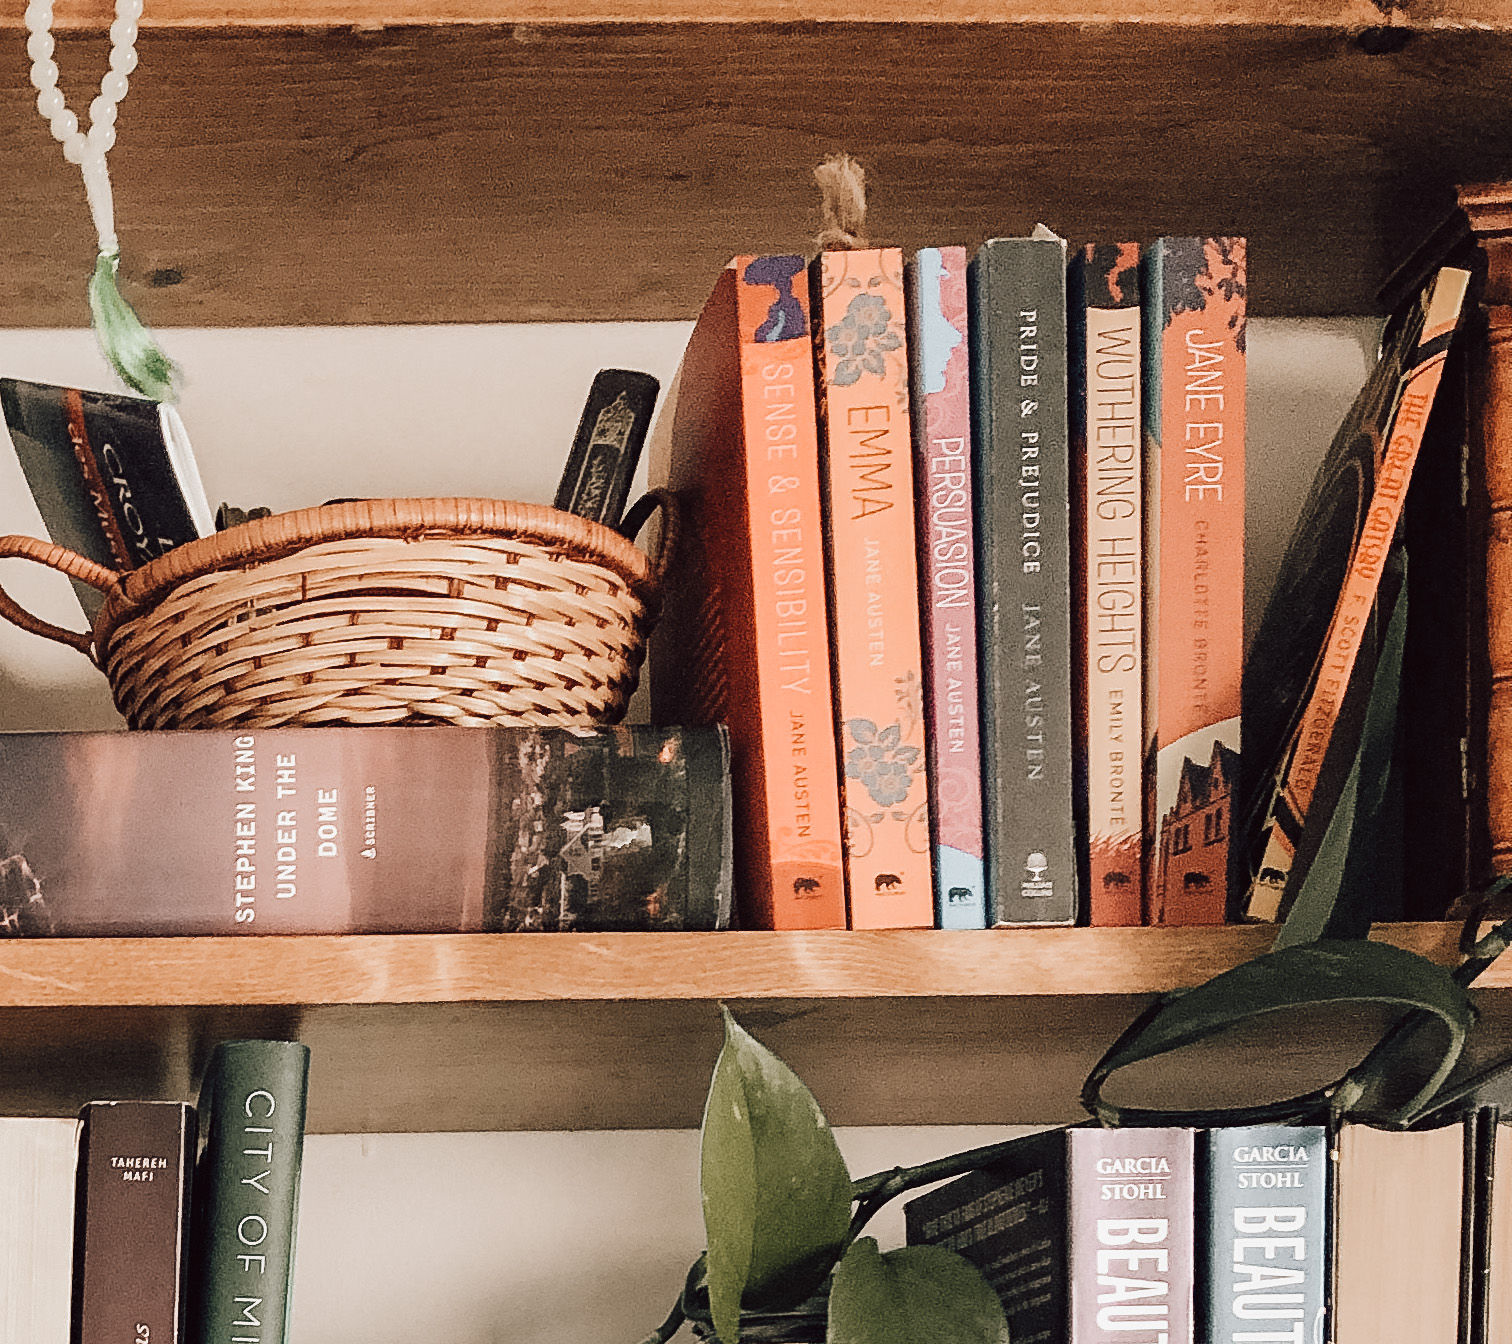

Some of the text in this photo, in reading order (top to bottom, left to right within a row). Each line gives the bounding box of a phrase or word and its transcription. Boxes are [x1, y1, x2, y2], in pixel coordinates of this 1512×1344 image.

[848, 405, 894, 520] EMMA
[1019, 309, 1041, 574] PRIDE & PREJUDICE
[1185, 329, 1224, 502] JANE EYRE
[762, 363, 812, 695] SENSE & SENSIBILITY
[931, 437, 970, 609] PERSUASION
[1096, 327, 1136, 674] WUTHERING HEIGHTS
[234, 735, 256, 924] STEPHEN KING
[276, 753, 297, 899] UNDER THE
[318, 788, 338, 858] DOME
[110, 1157, 167, 1169] TAHEREH
[123, 1171, 154, 1182] MAFI
[241, 1090, 276, 1194] CITY
[1096, 1157, 1171, 1176] GARCIA
[1101, 1184, 1167, 1201] STOHL
[1233, 1145, 1309, 1162] GARCIA
[1238, 1171, 1303, 1188] STOHL
[237, 1215, 268, 1274] OF
